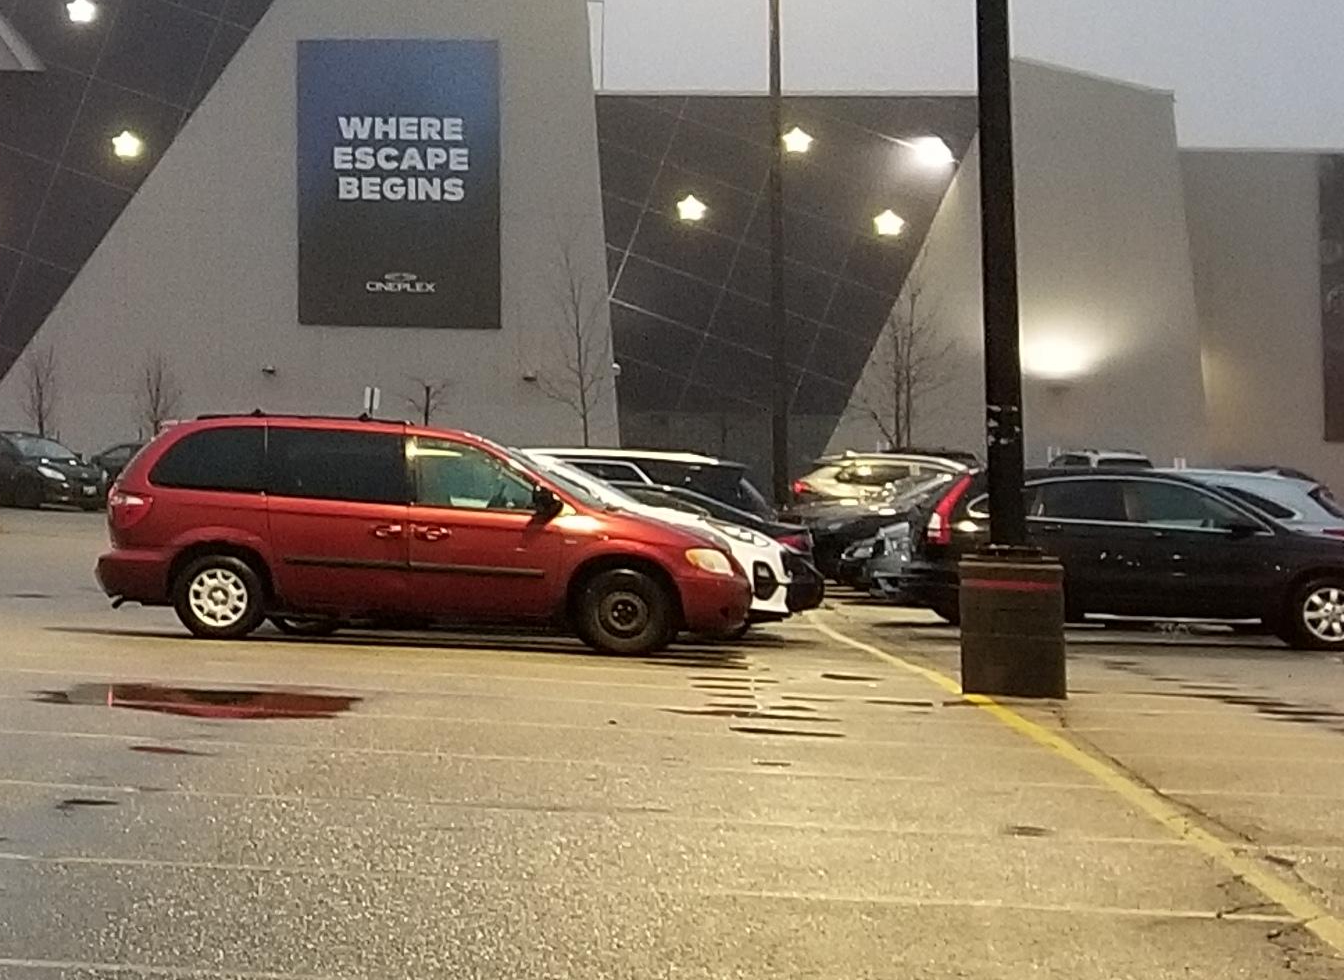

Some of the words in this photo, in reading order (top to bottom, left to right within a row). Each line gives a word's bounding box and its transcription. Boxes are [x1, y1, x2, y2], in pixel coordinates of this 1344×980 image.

[337, 116, 463, 141] WHERE
[333, 146, 469, 171] ESCAPE
[338, 176, 465, 201] BEGINS
[365, 281, 437, 293] CINEPLEX
